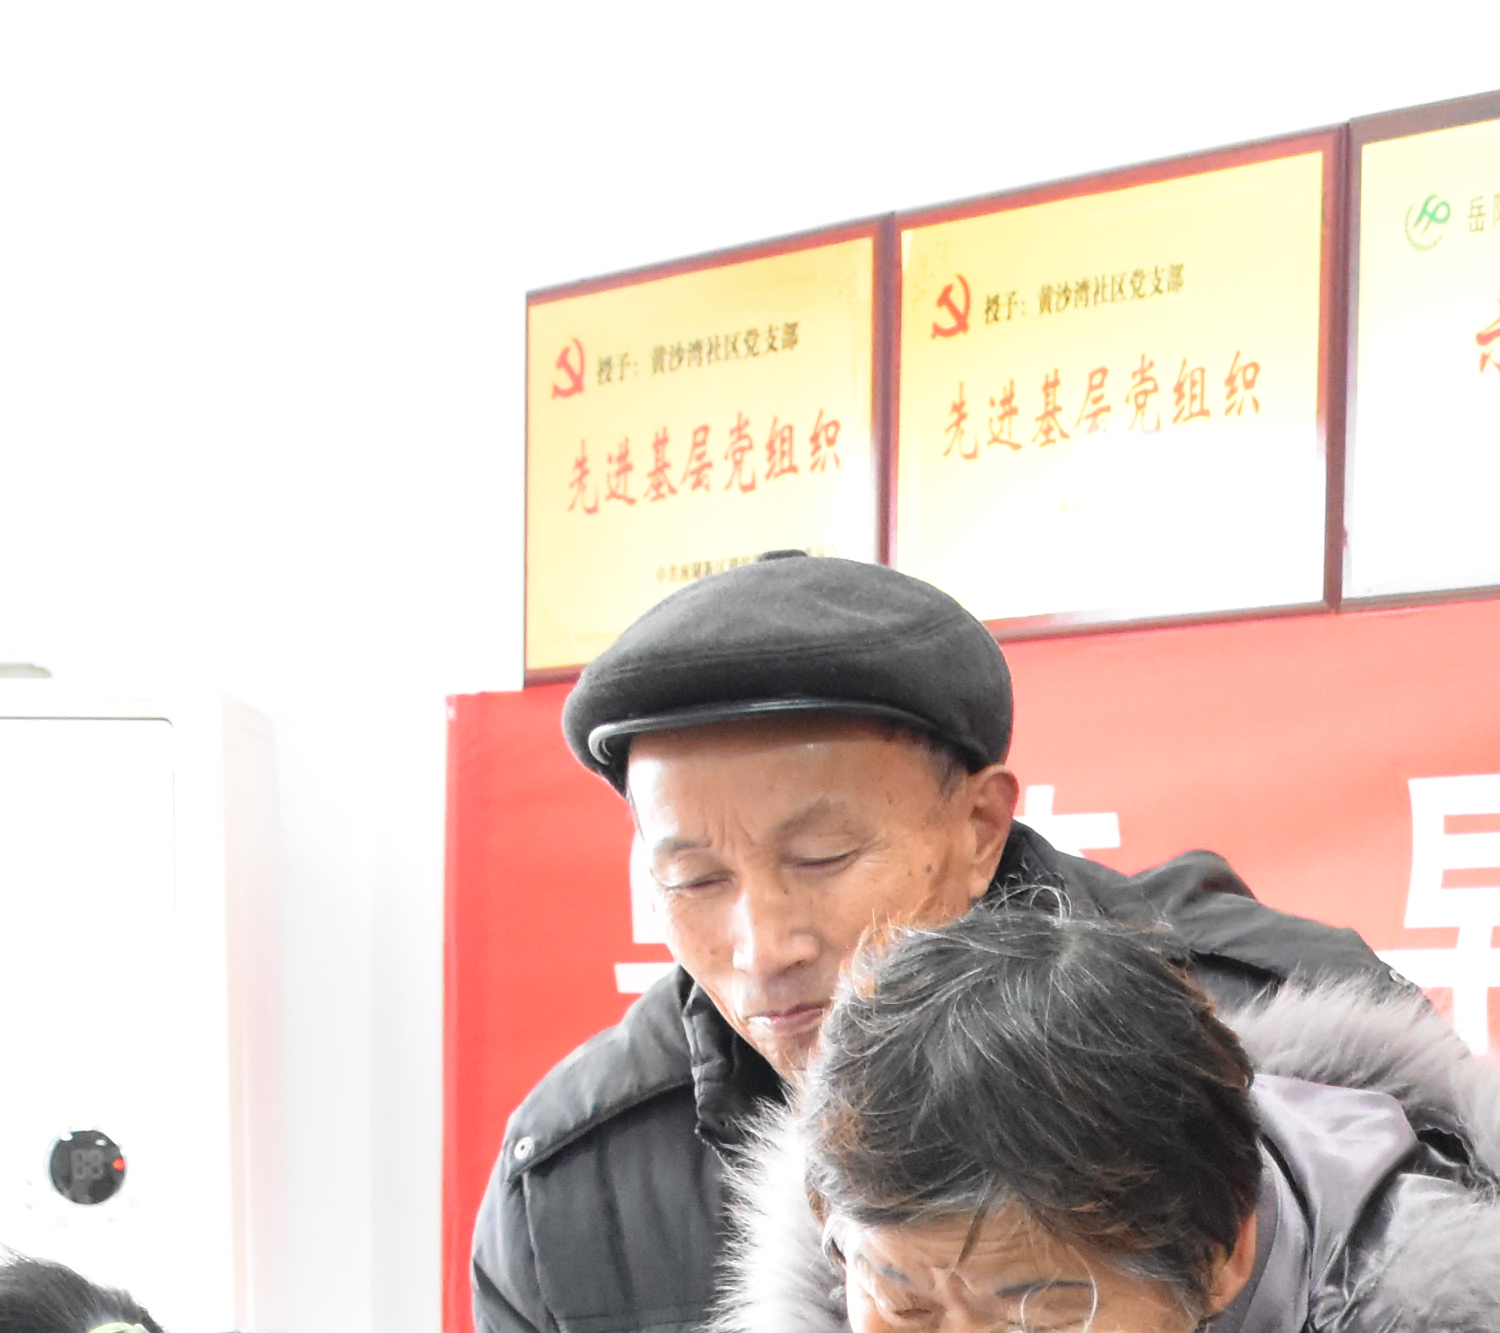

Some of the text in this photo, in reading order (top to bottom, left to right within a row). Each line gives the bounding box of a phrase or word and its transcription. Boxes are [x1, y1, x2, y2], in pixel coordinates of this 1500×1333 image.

[943, 350, 1261, 461] 先进基层党组织
[567, 408, 841, 514] 先进基层党组织
